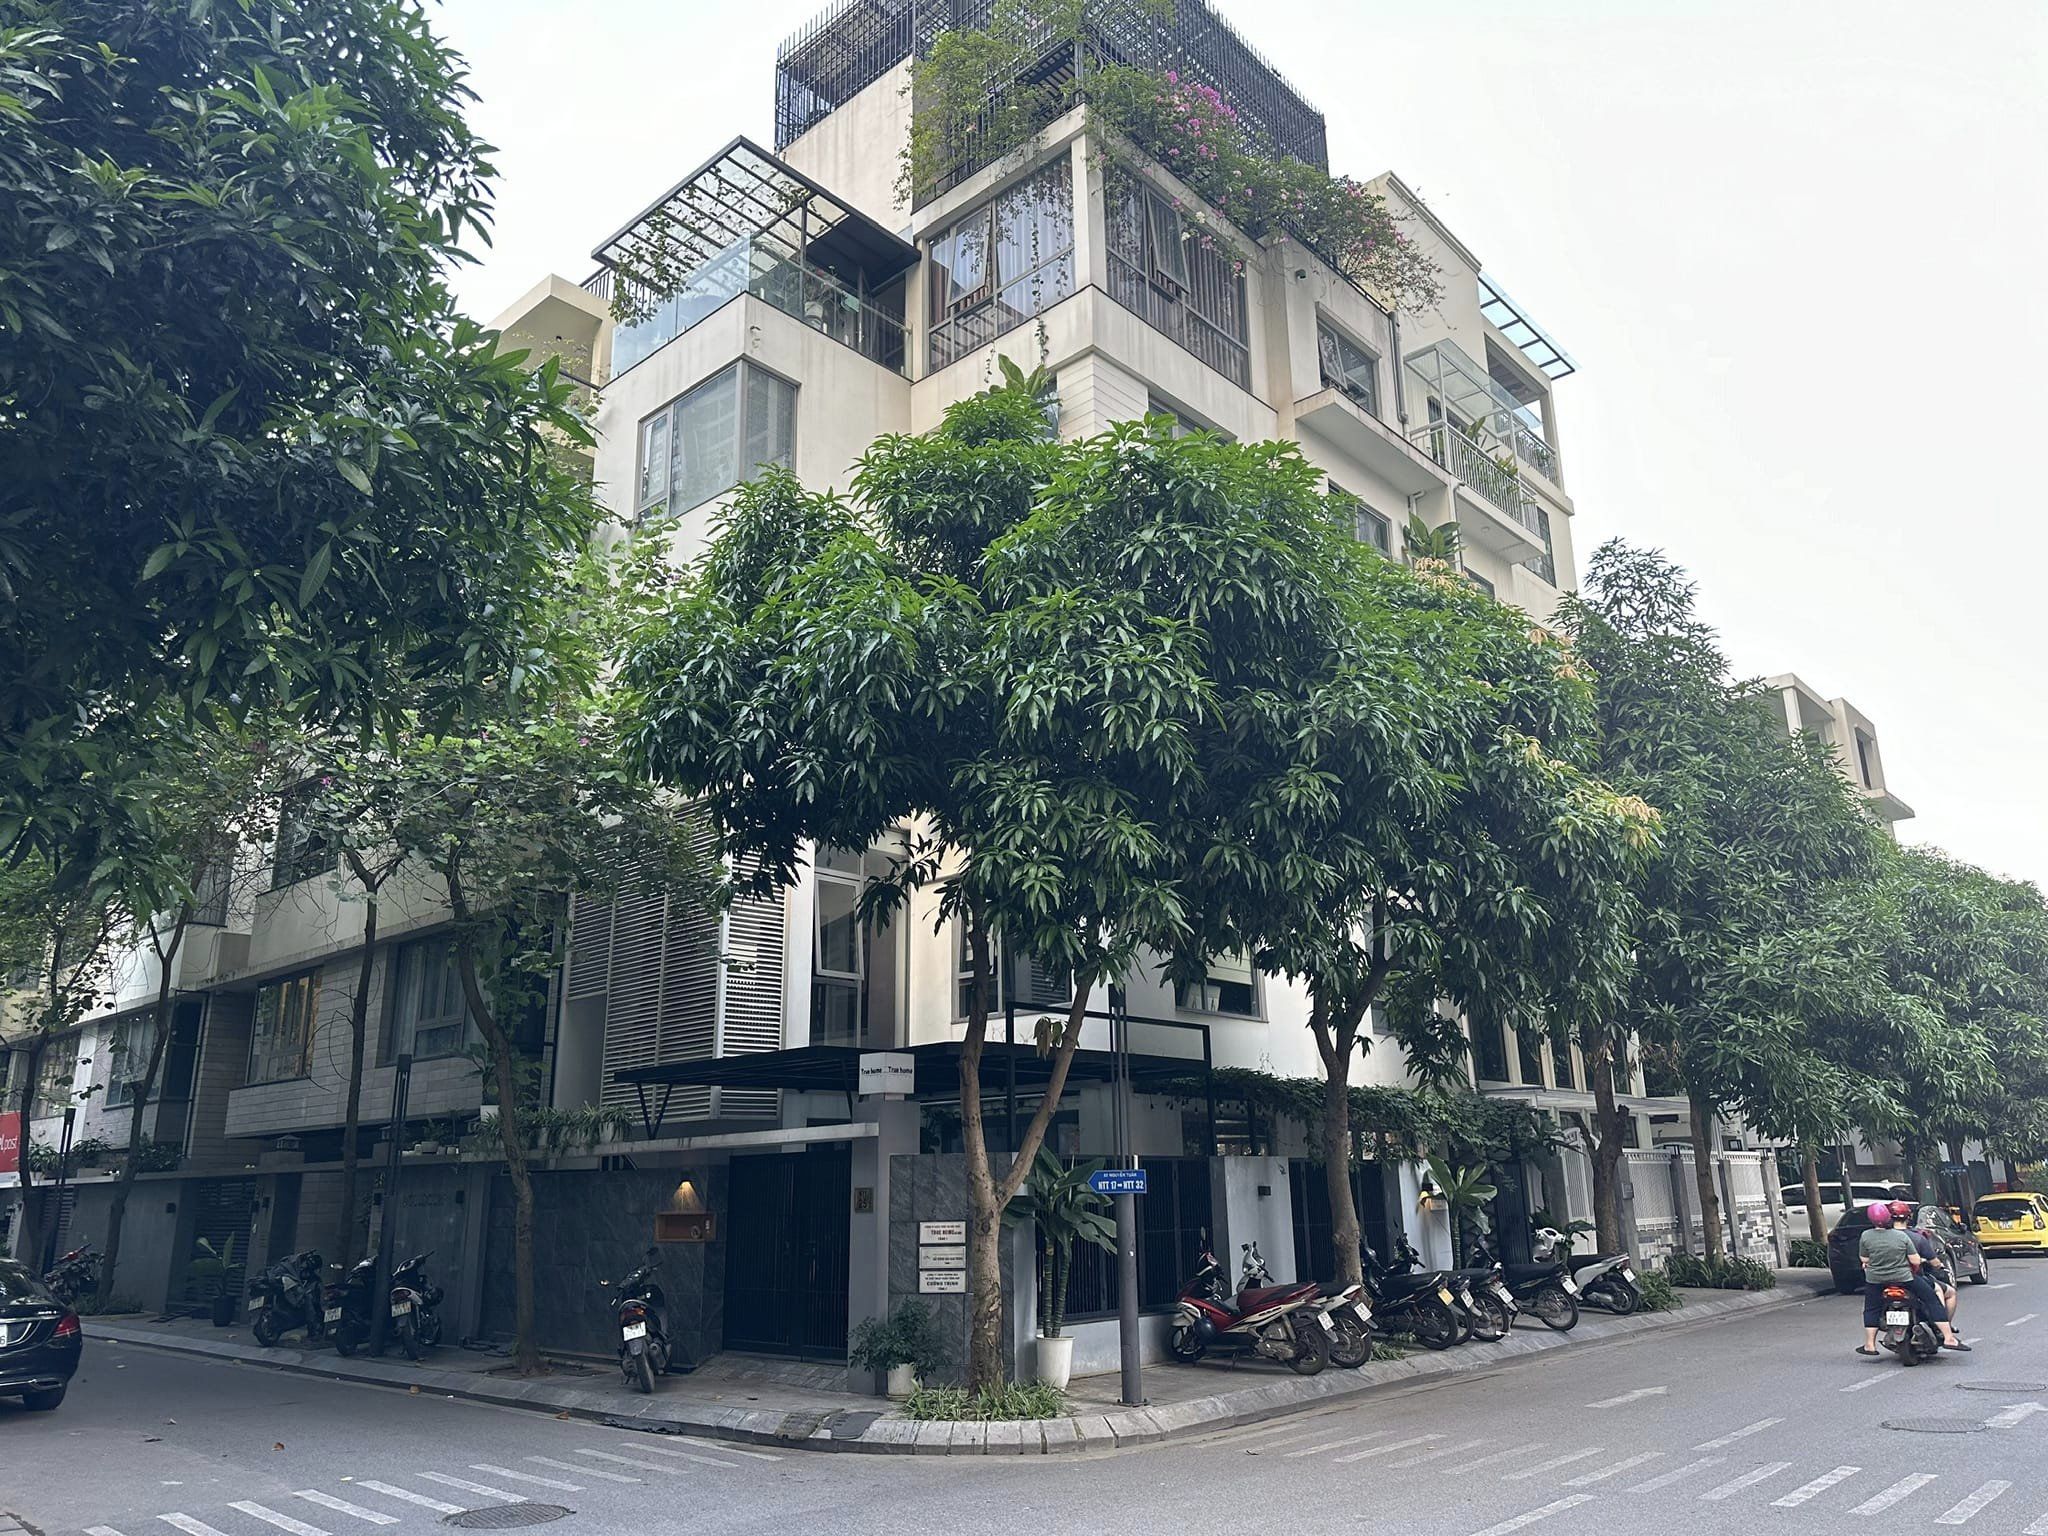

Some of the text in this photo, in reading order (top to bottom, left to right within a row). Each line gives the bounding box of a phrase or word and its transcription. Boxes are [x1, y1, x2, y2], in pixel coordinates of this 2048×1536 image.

[1098, 1181, 1110, 1190] NTT
[1111, 1181, 1117, 1190] 17
[1123, 1181, 1135, 1190] NTT
[1136, 1180, 1144, 1189] 32
